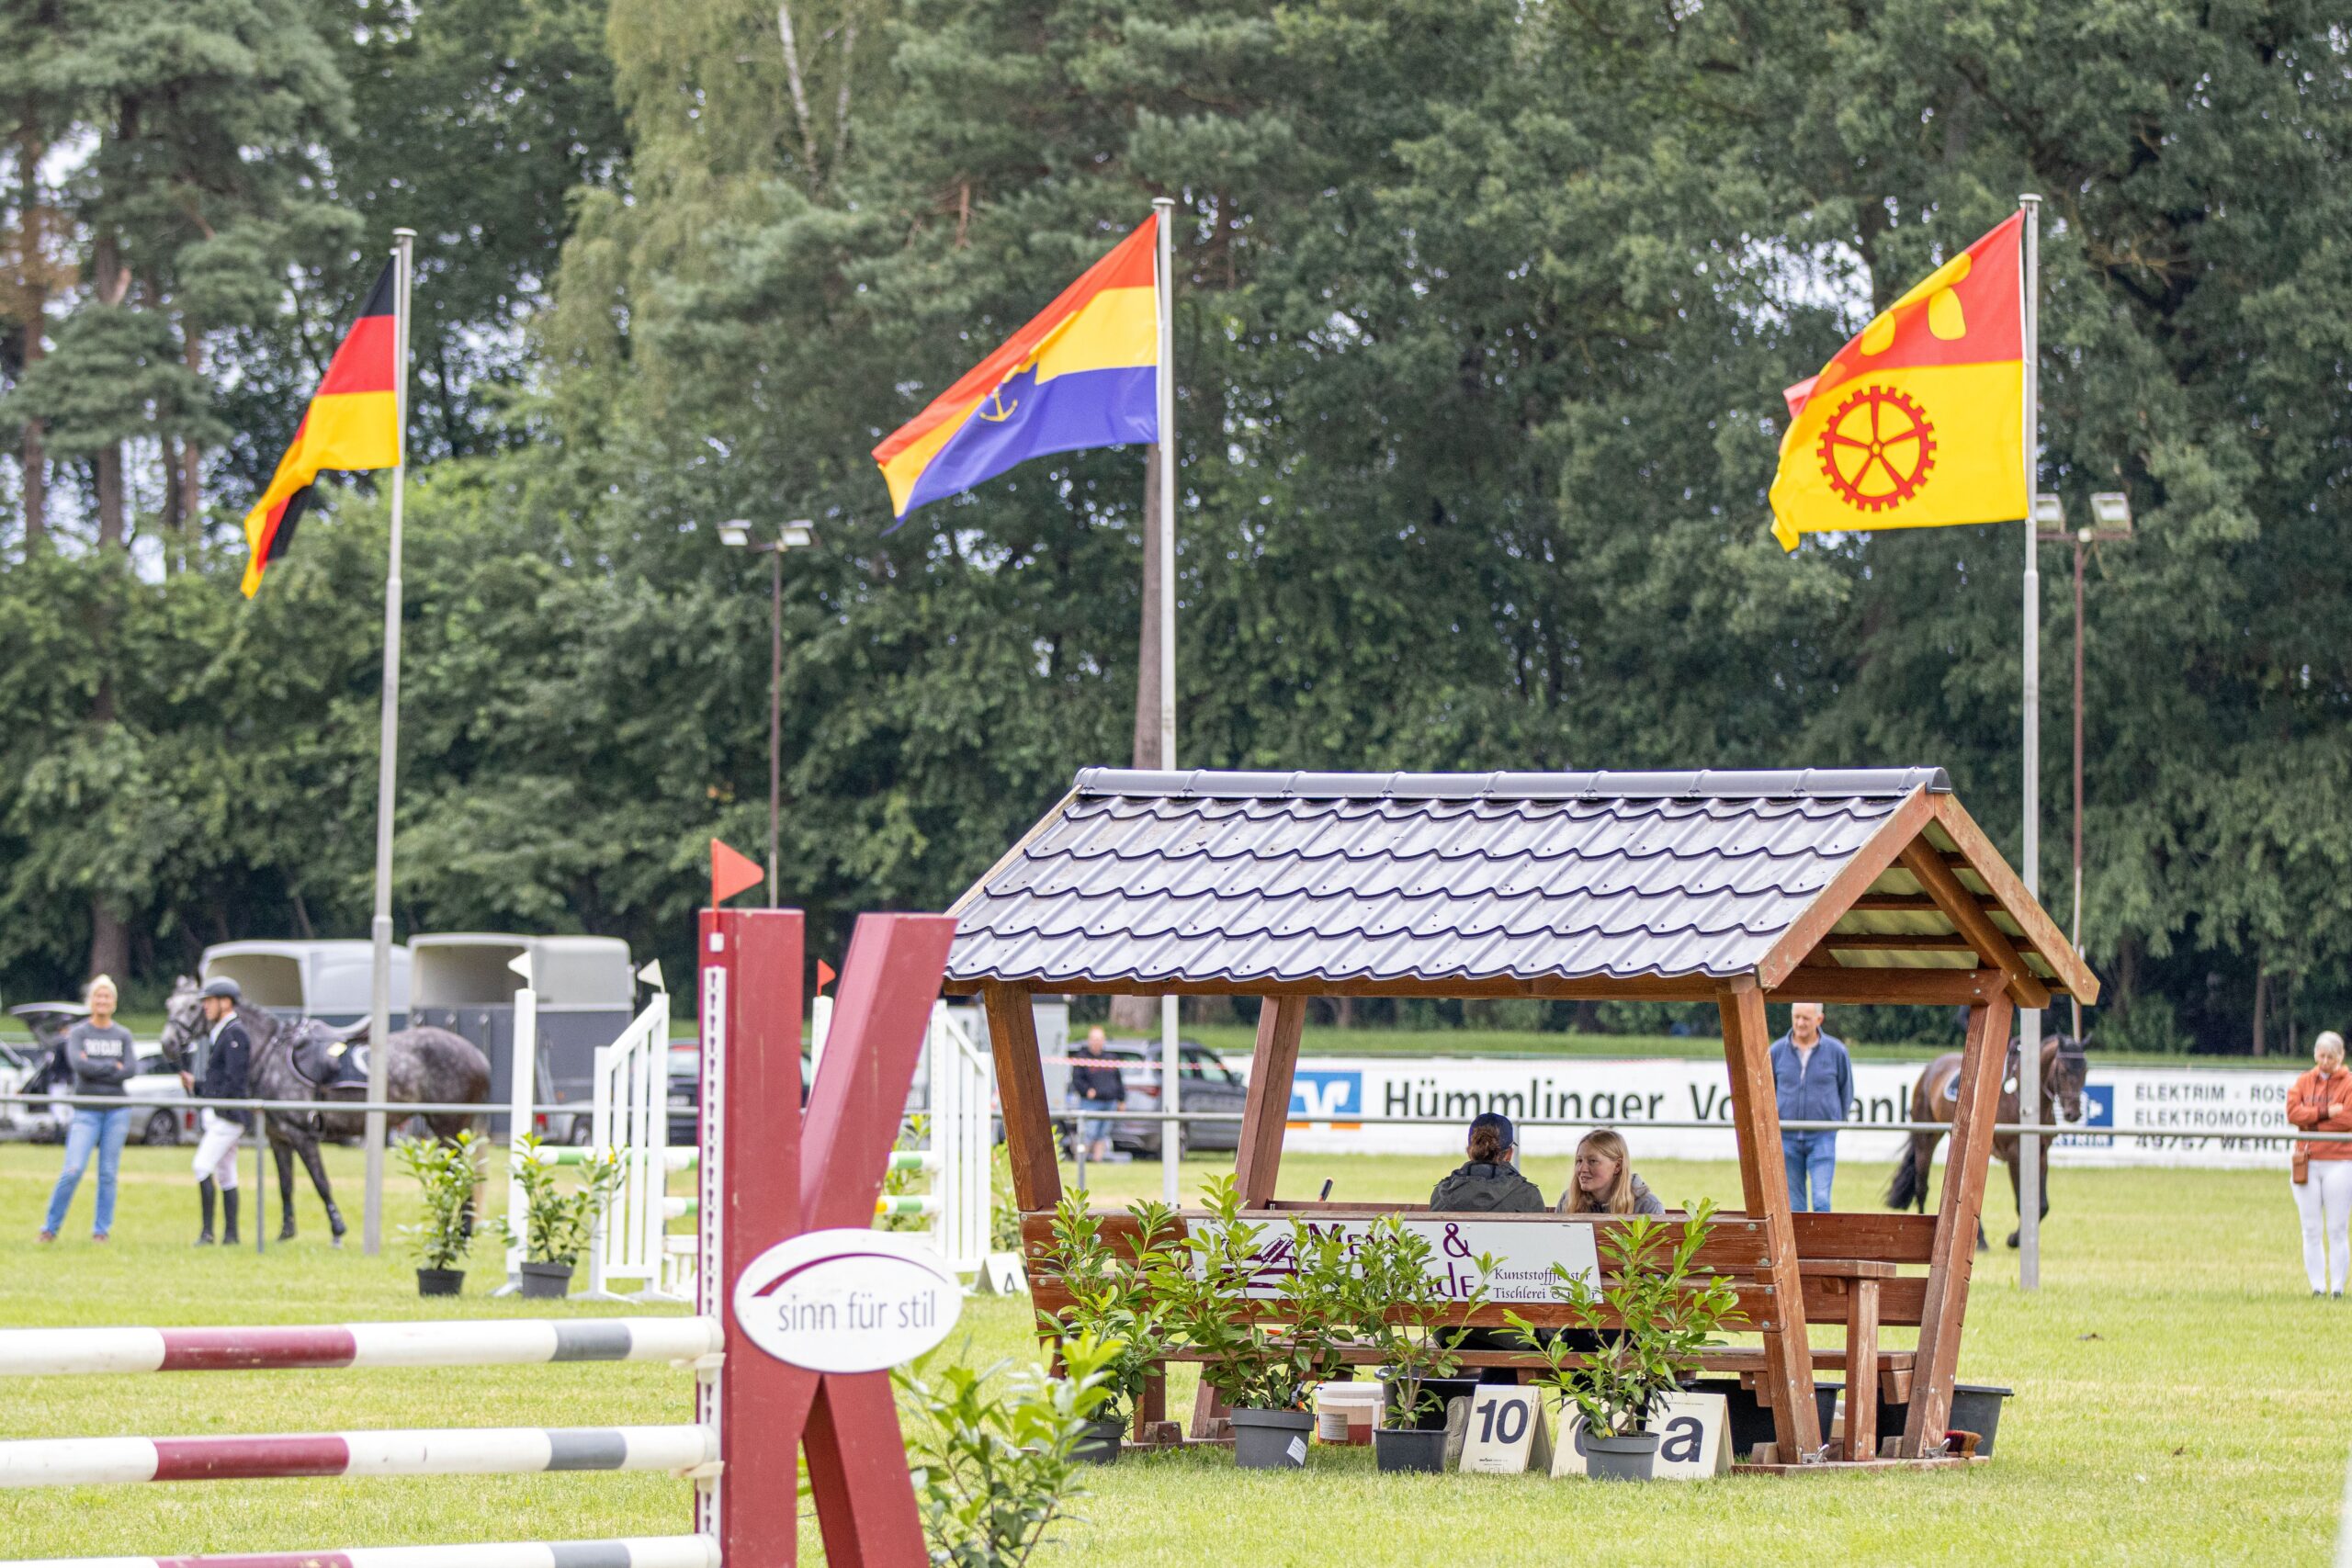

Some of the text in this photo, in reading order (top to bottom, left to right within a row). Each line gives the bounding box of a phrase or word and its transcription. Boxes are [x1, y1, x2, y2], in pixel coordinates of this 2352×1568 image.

[1385, 1078, 1664, 1120] Hümmlinger
[2135, 1084, 2225, 1101] ELEKTRIM
[2134, 1109, 2287, 1127] ELEKTROMOTOR
[778, 1285, 934, 1332] sinn für stil
[1493, 1286, 1546, 1299] Tischlerei
[1476, 1398, 1529, 1445] 10
[1660, 1416, 1704, 1463] a
